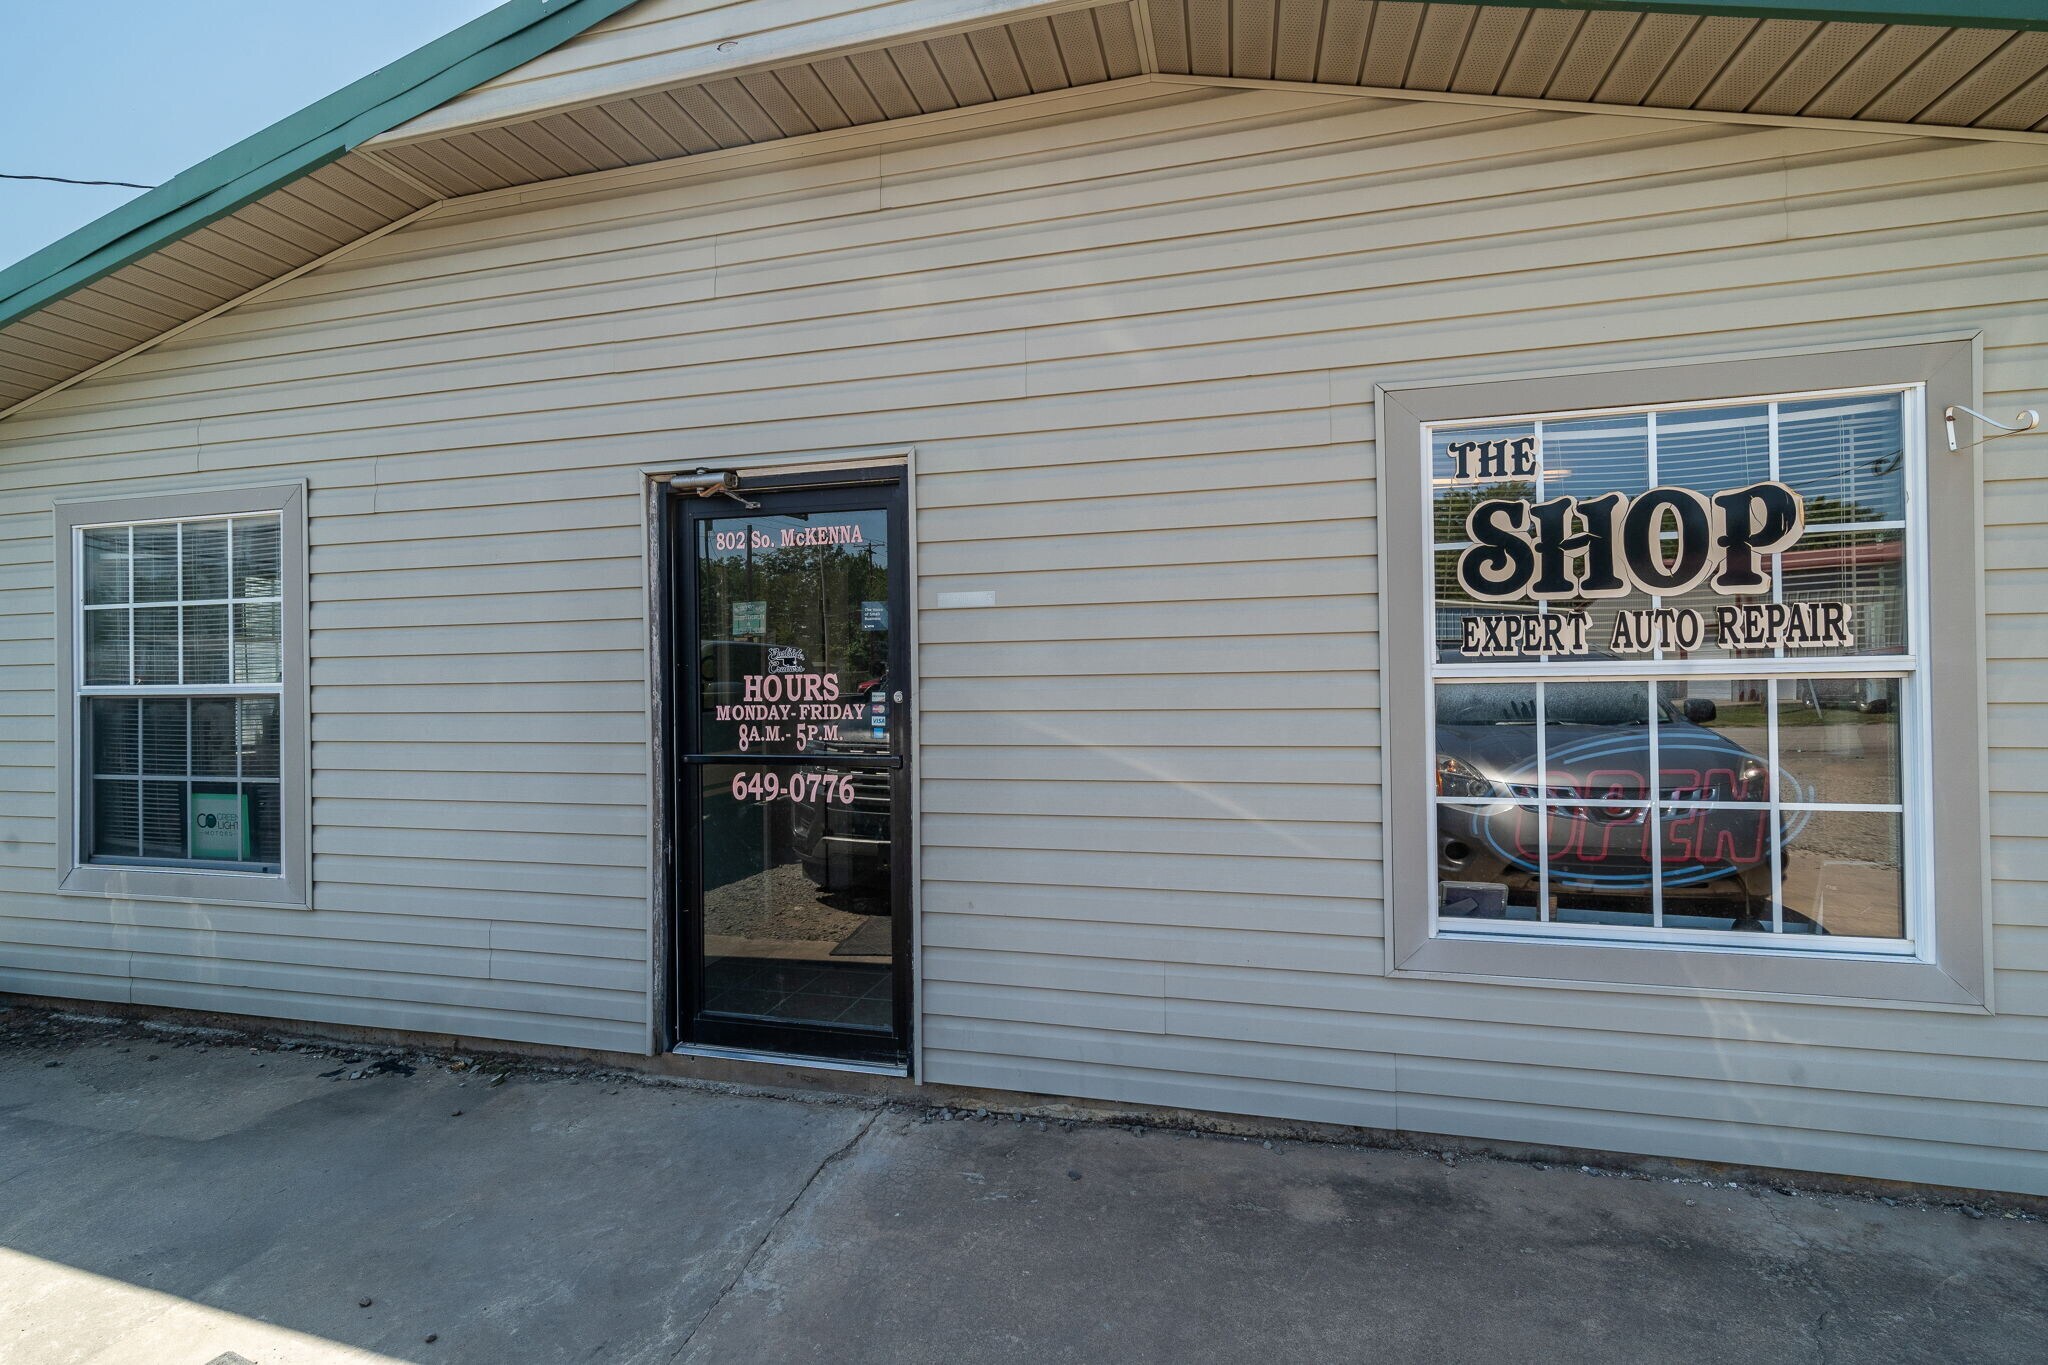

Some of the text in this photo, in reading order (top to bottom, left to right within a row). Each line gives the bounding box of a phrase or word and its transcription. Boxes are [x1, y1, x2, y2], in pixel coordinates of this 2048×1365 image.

[1448, 435, 1540, 483] THE
[716, 524, 863, 550] 802 So. McKENNA
[1457, 481, 1805, 601] SHOP
[1460, 602, 1854, 657] EXPERT AUTO REPAIR
[743, 673, 839, 702] HOURS
[732, 772, 855, 804] 649-0776
[1514, 768, 1770, 864] OPEN
